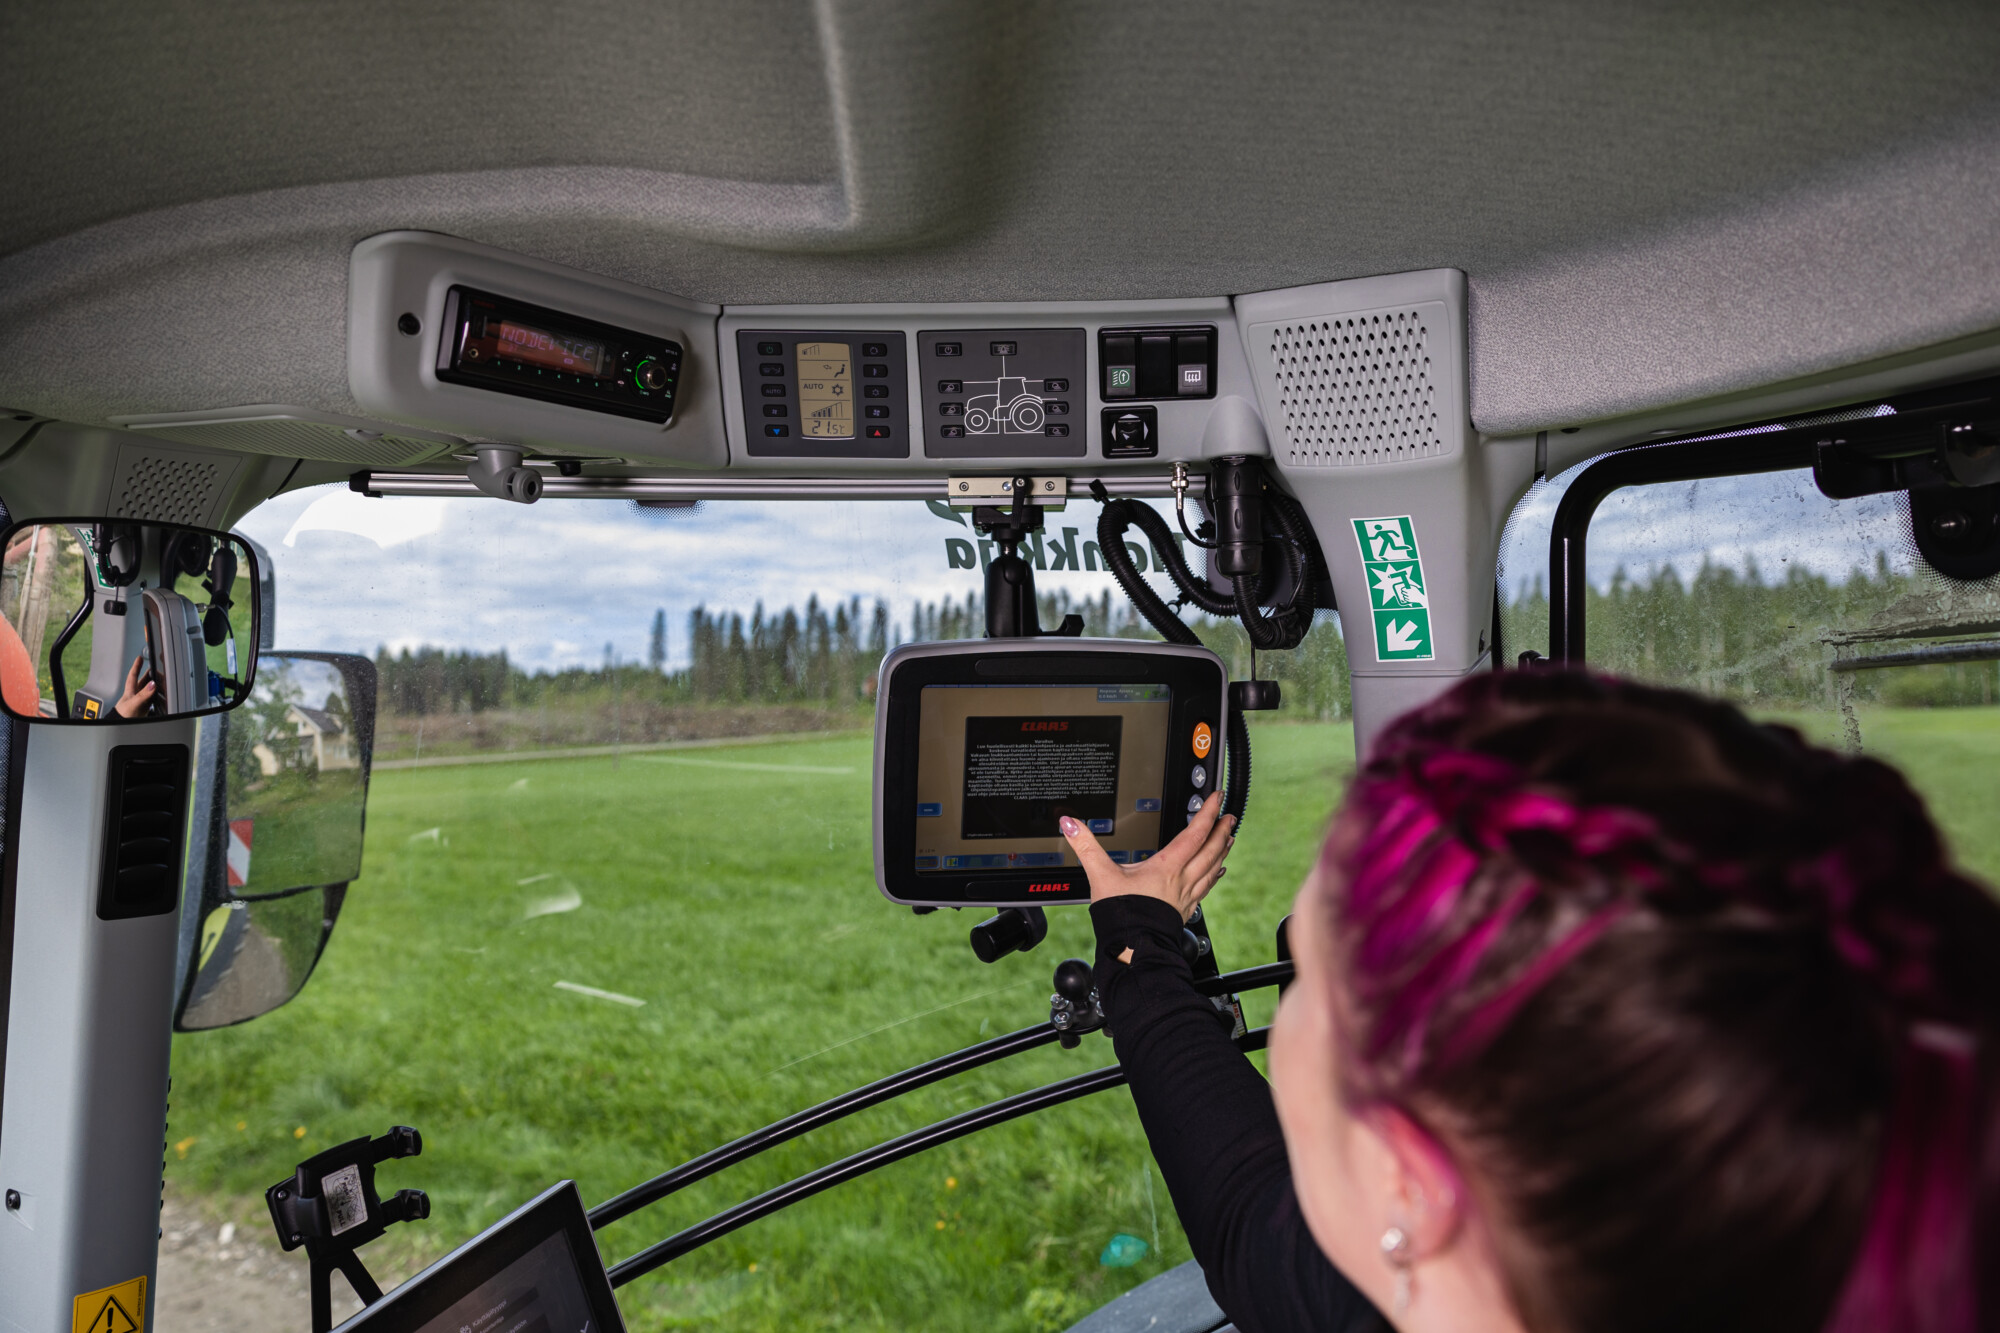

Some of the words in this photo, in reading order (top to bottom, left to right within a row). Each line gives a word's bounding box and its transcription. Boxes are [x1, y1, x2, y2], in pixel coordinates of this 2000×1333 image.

[1021, 722, 1069, 731] CLAAS
[1028, 882, 1070, 892] CLAAS
[336, 1210, 346, 1227] PULL
